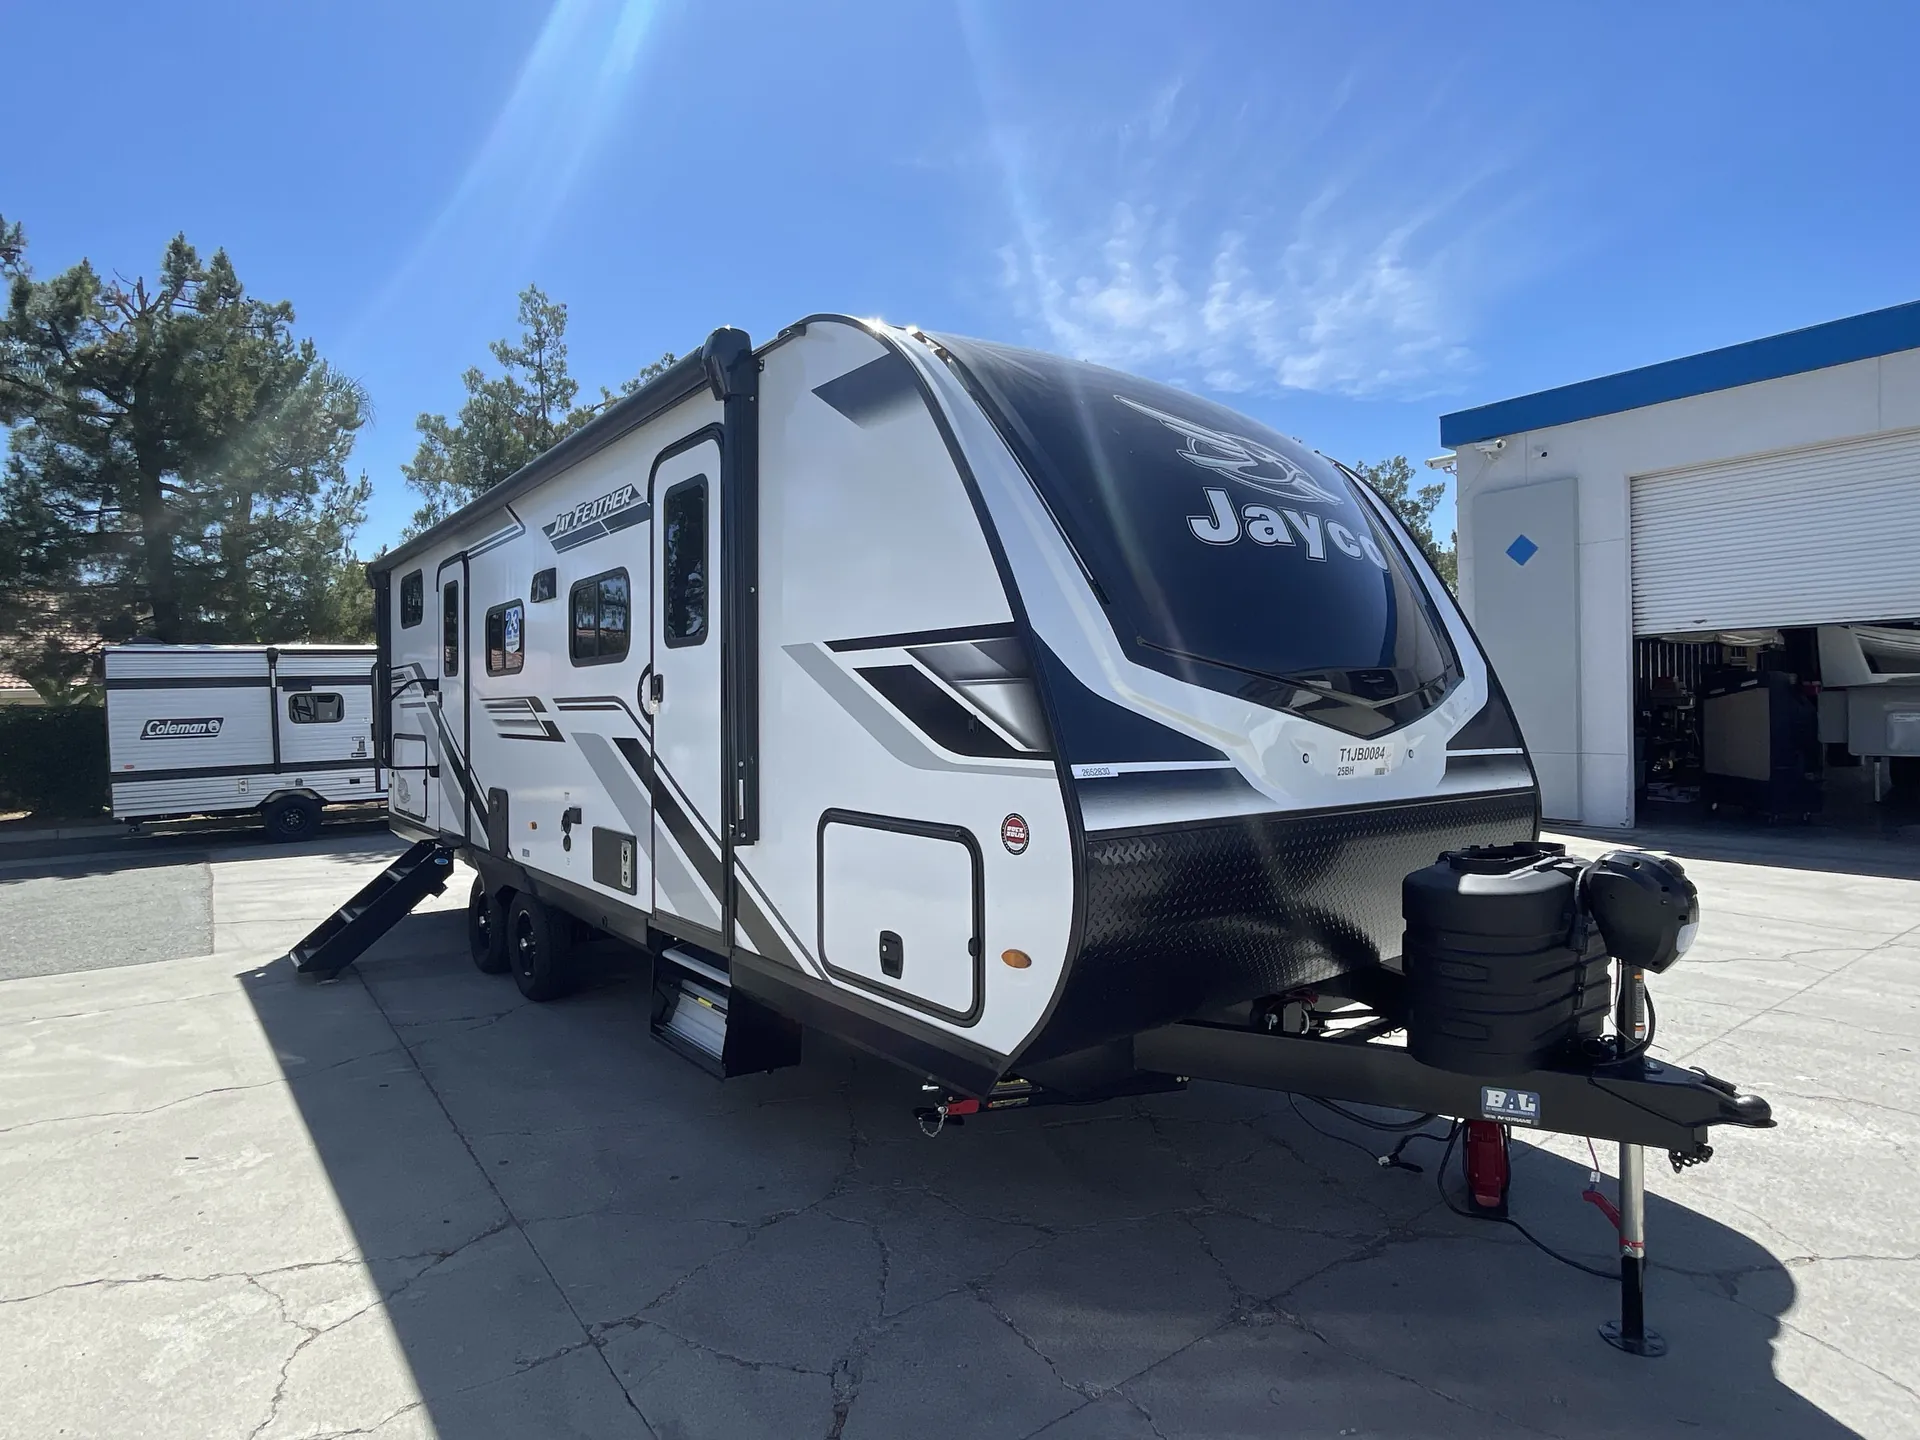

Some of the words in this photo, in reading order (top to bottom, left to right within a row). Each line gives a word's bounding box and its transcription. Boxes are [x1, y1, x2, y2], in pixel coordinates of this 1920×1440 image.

[549, 513, 573, 537] JAY
[572, 485, 633, 527] FEATHER
[1186, 487, 1390, 573] Jayco
[146, 720, 207, 736] Coleman
[1337, 766, 1355, 776] 25BH
